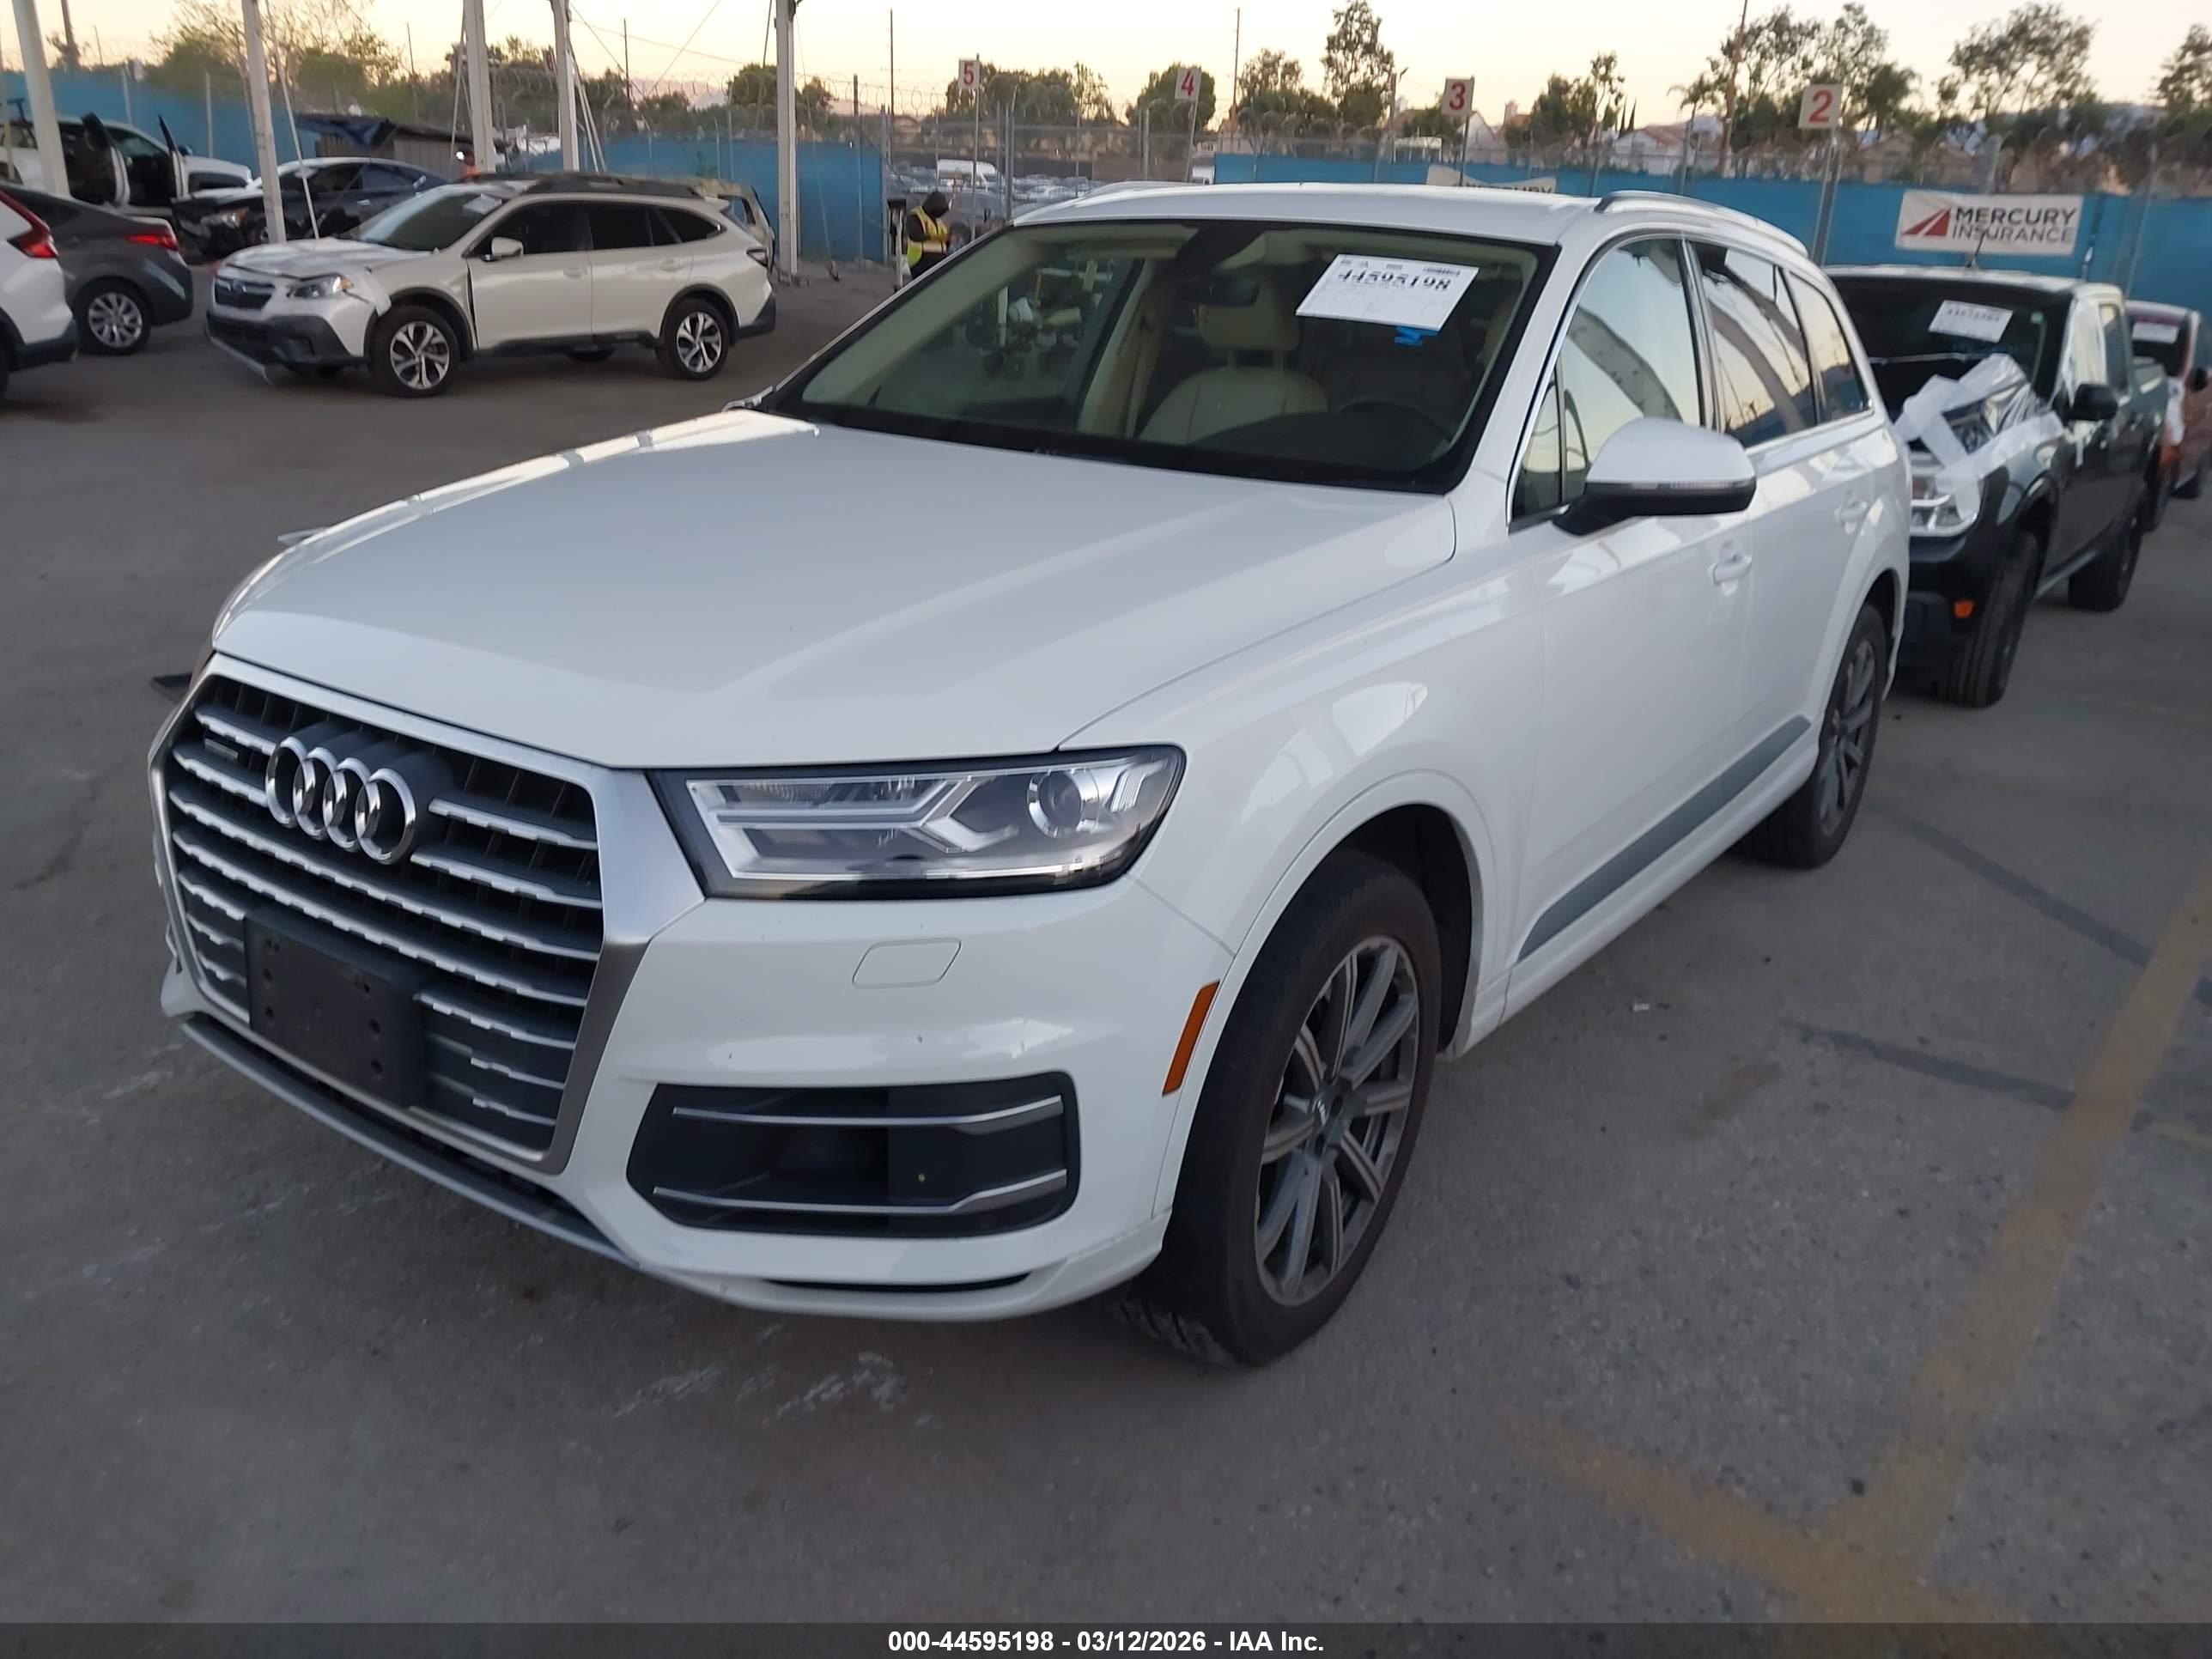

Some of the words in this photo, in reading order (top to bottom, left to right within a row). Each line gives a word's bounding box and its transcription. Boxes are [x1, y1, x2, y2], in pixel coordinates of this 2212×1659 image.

[963, 61, 975, 85] 5
[1181, 70, 1194, 96] 4
[1449, 82, 1467, 111] 3
[1808, 89, 1833, 122] 2
[1955, 207, 2077, 226] MERCURY
[1953, 224, 2075, 244] INSURANCE
[1338, 269, 1451, 290] 44595198
